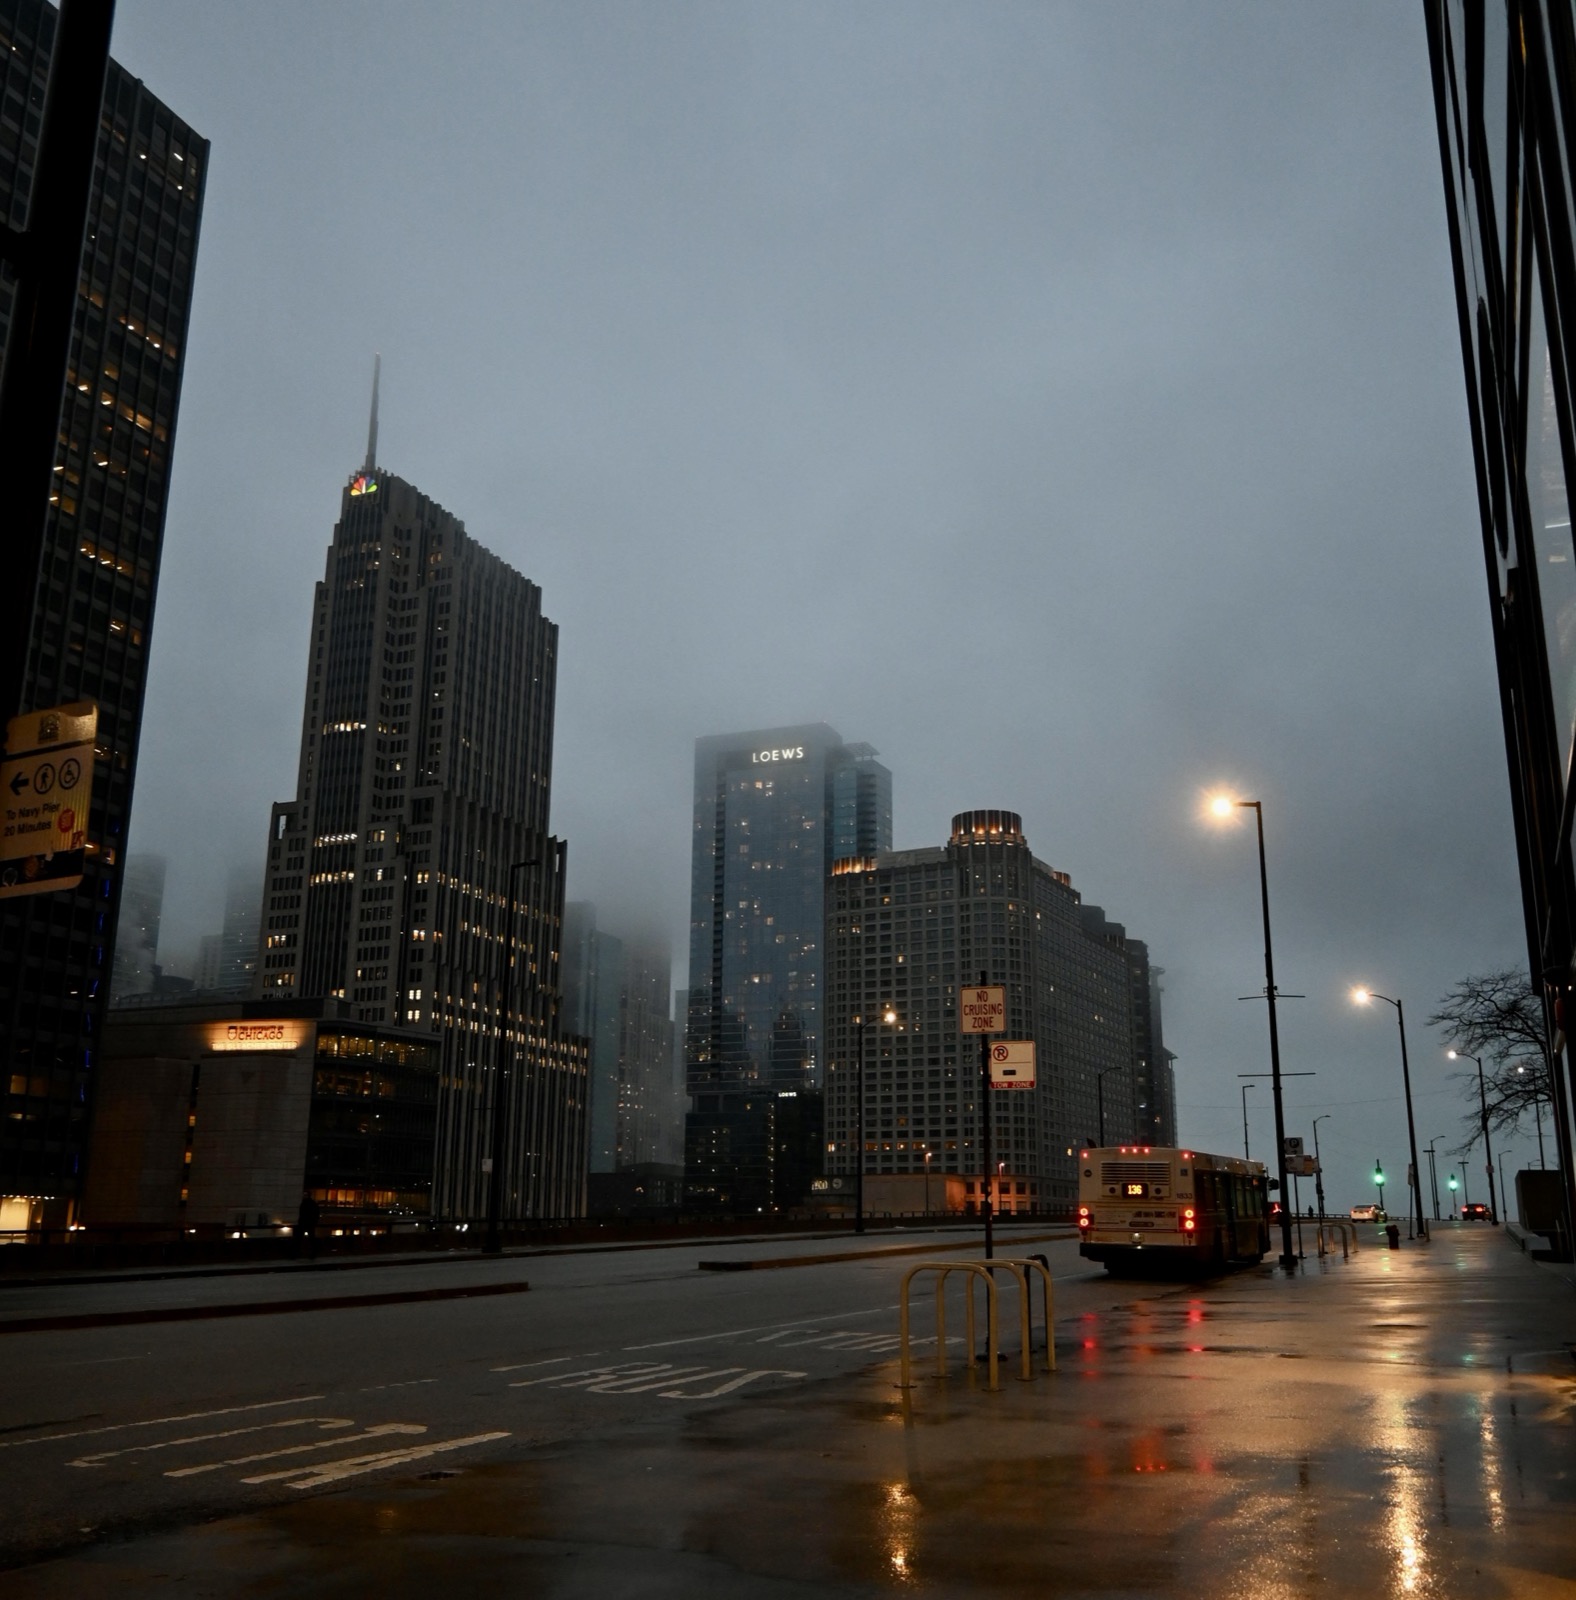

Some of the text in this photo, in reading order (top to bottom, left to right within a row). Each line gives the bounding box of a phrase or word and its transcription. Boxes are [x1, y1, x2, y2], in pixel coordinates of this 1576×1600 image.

[752, 746, 804, 763] LOEWS
[6, 803, 60, 820] To Navy Pier
[4, 825, 15, 836] 20
[17, 820, 52, 834] Minutes
[976, 990, 988, 1003] NO
[963, 1003, 1003, 1016] CRUISING
[972, 1016, 994, 1028] ZONE
[238, 1031, 283, 1040] CHICAGO
[993, 1081, 1009, 1089] TOW
[1127, 1184, 1142, 1195] 136
[508, 1361, 808, 1399] BUS
